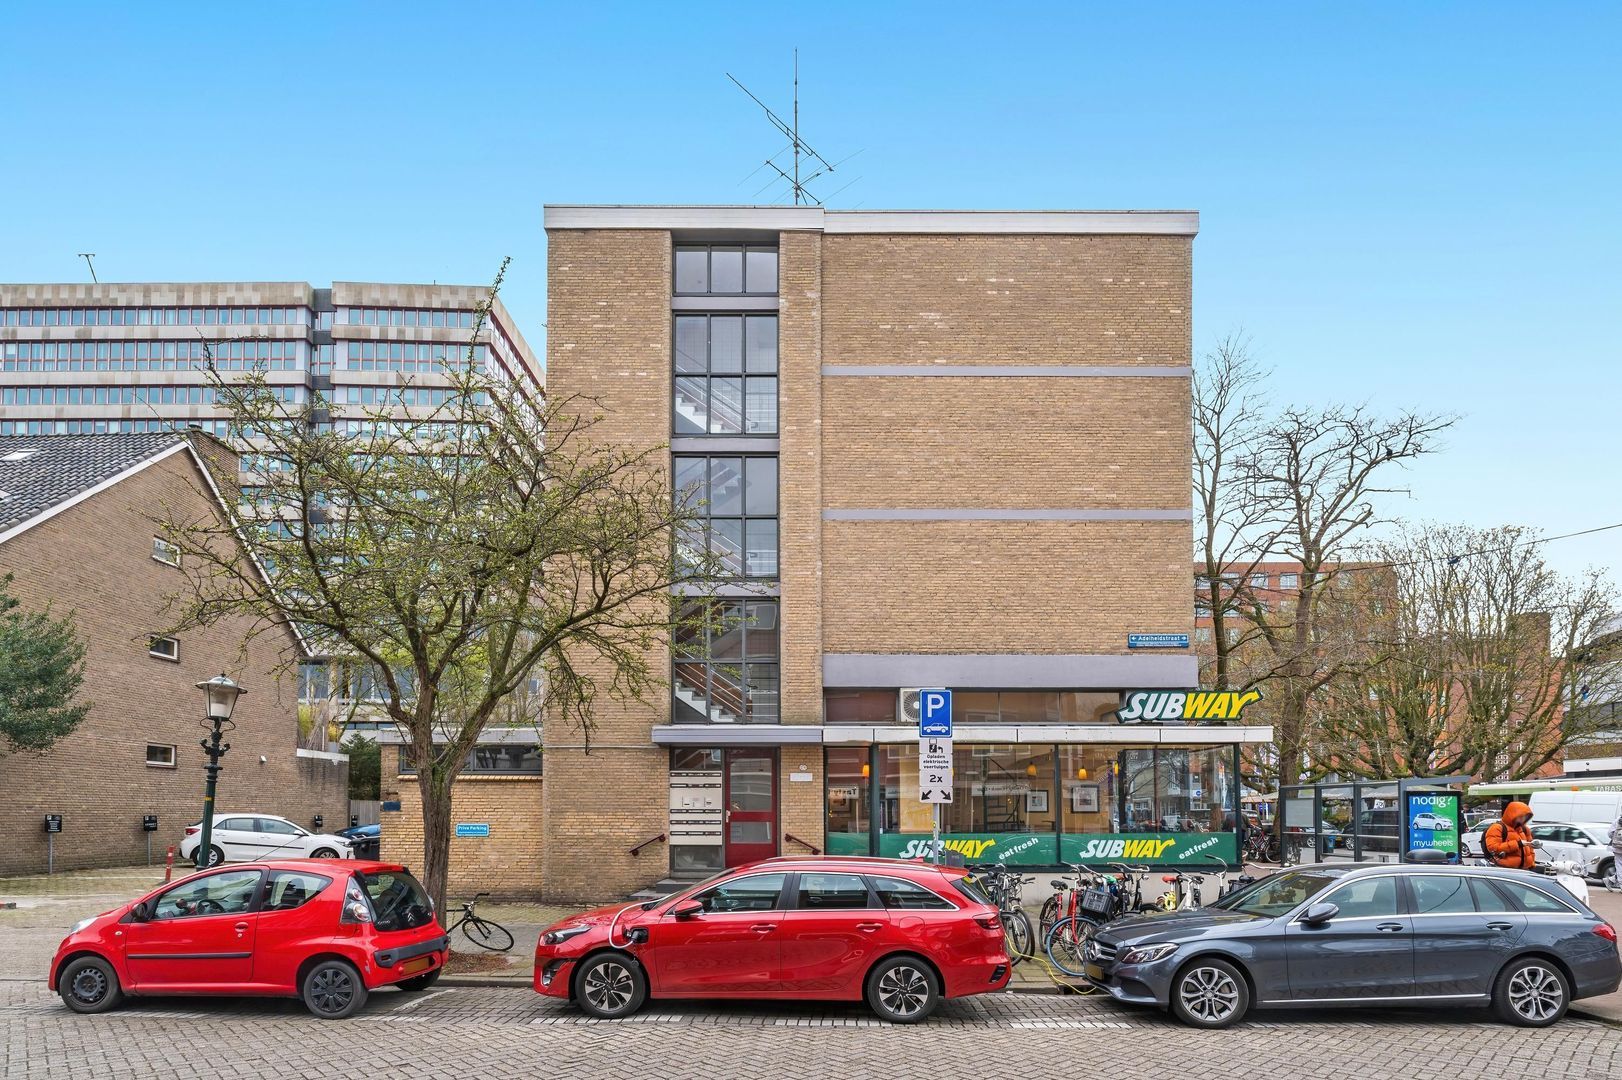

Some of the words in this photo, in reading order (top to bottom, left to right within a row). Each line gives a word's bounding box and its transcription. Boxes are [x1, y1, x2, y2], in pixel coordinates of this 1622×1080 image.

[927, 694, 945, 718] P
[1119, 690, 1260, 720] SUBWAY
[929, 774, 943, 783] 2x
[998, 848, 1015, 860] eat
[1015, 837, 1039, 852] fresh
[1079, 838, 1176, 859] SUBWAY
[1178, 848, 1194, 860] eat
[1194, 836, 1219, 852] fresh
[1413, 839, 1454, 848] mywheels
